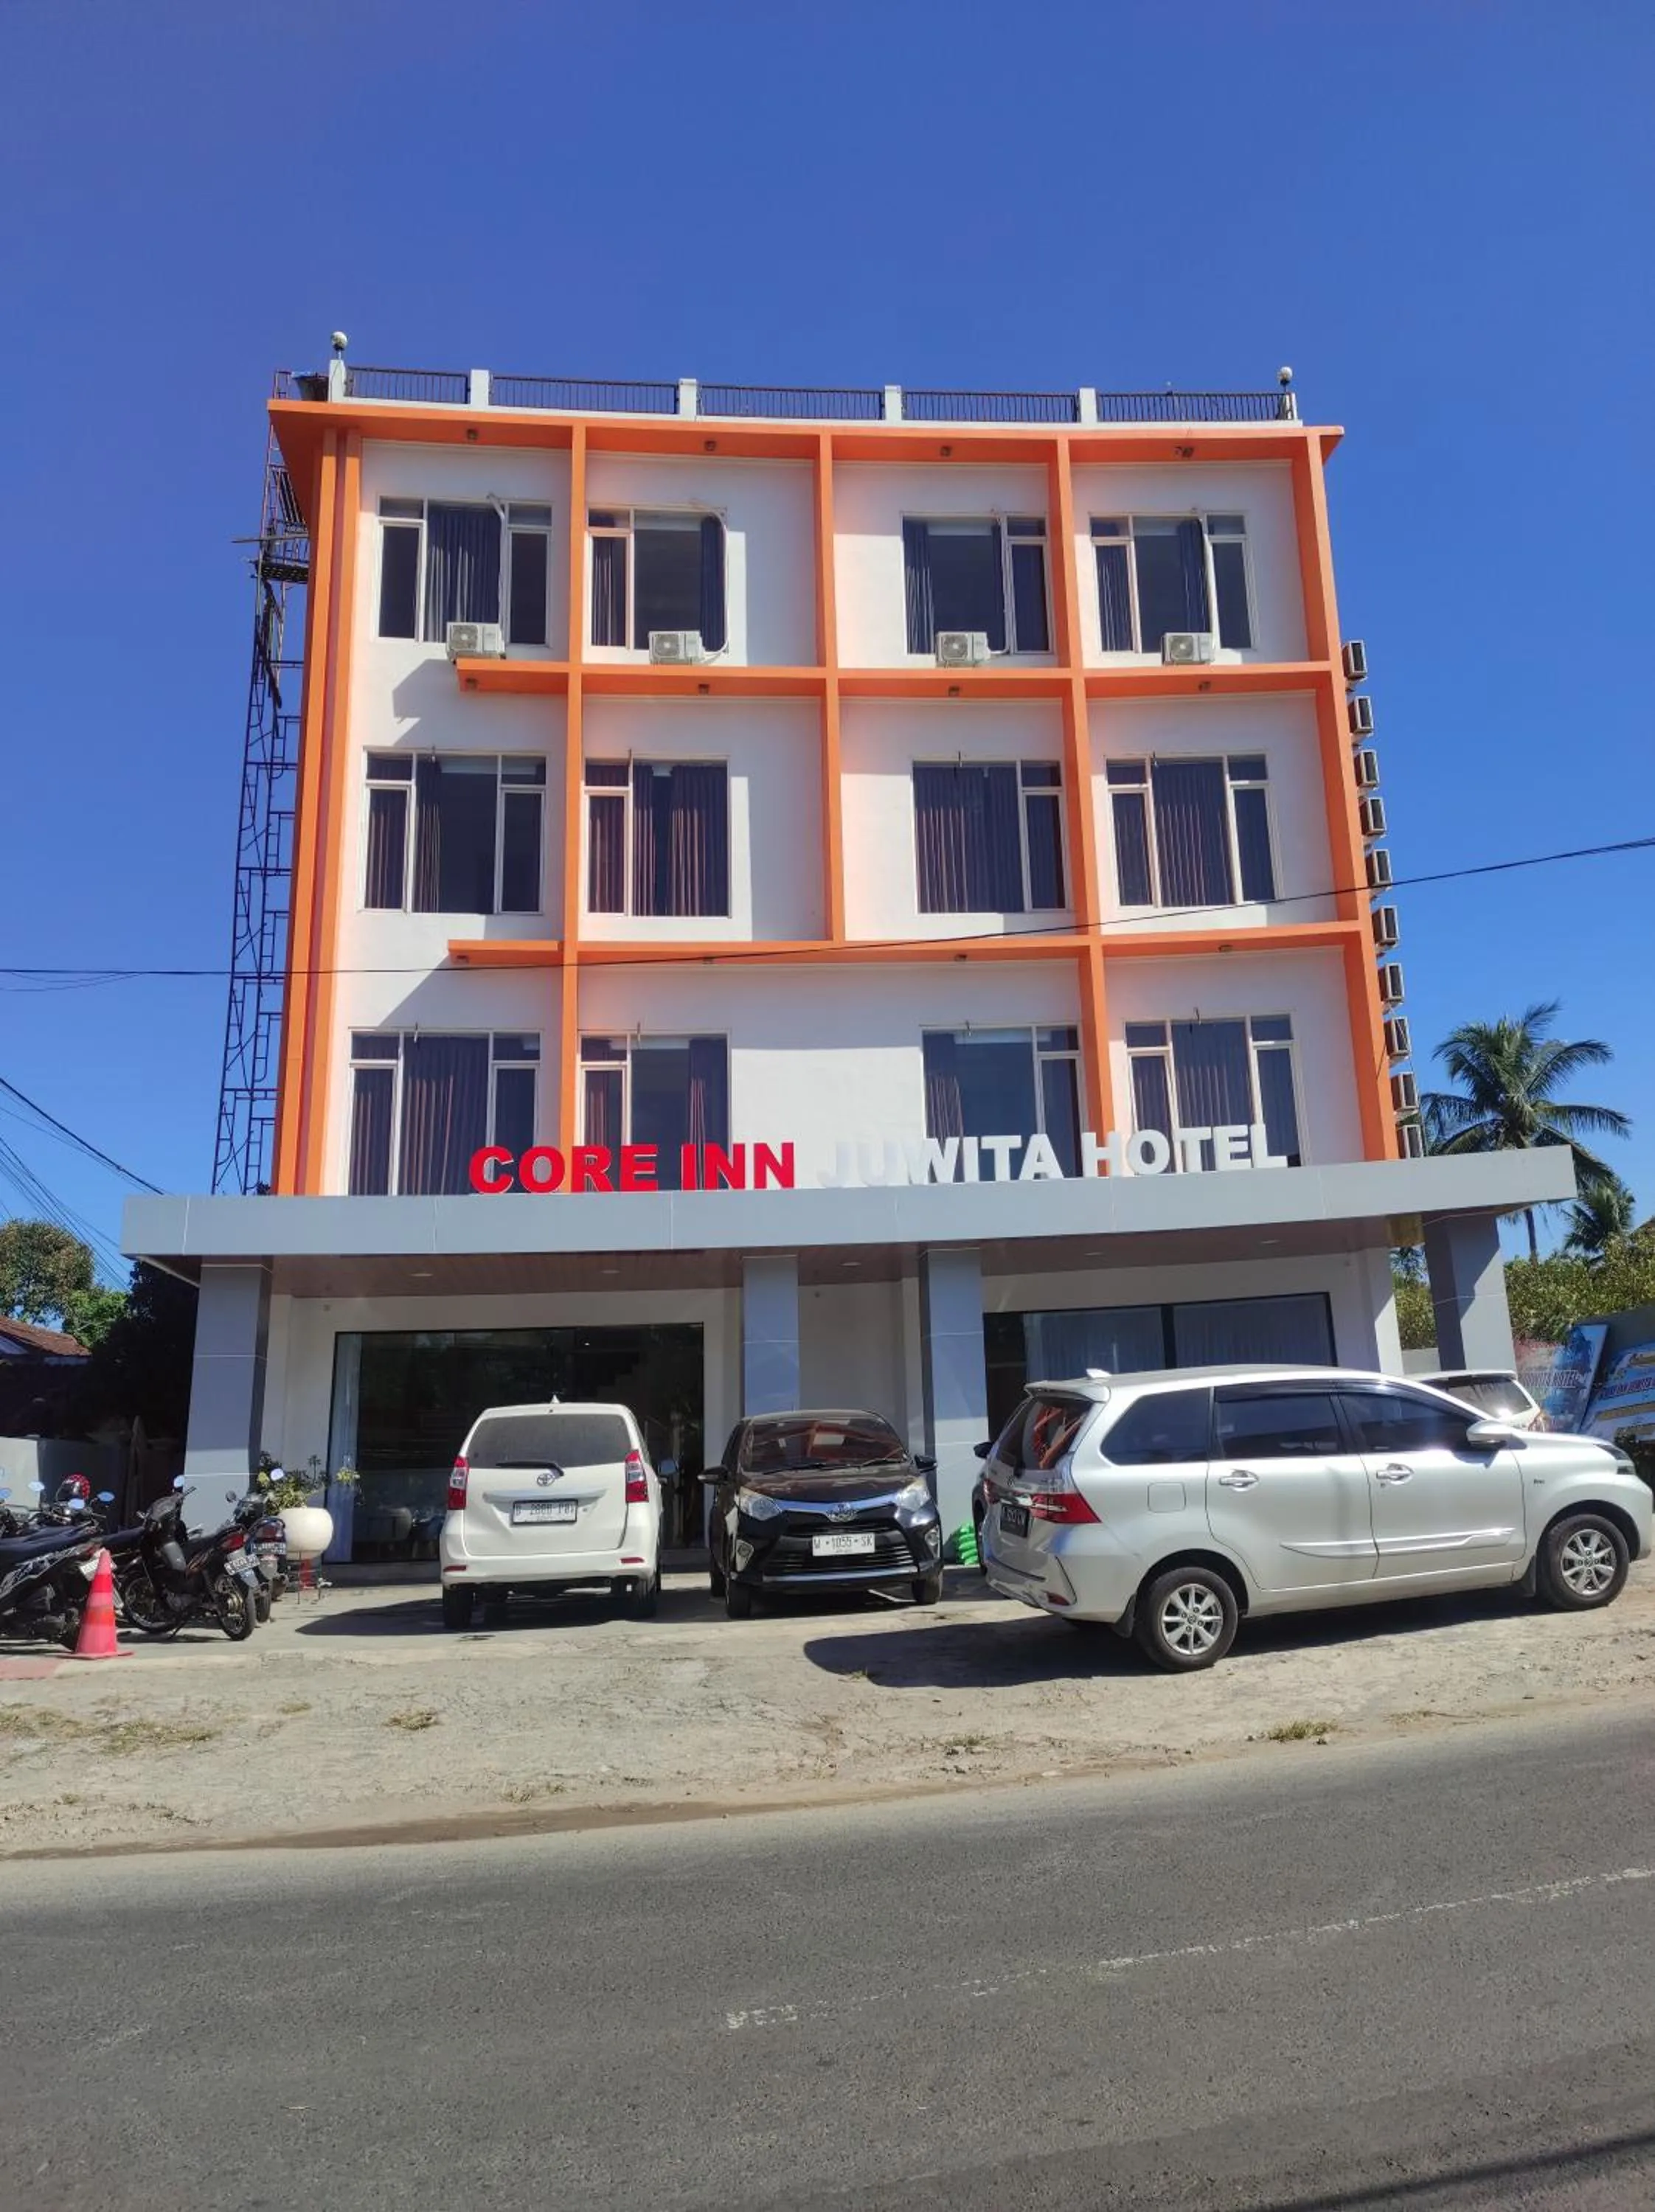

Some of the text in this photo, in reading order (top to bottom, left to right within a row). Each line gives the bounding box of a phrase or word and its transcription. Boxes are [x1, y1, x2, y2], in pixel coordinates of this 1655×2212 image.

[469, 1124, 1288, 1194] CORE INN JUWITA HOTEL
